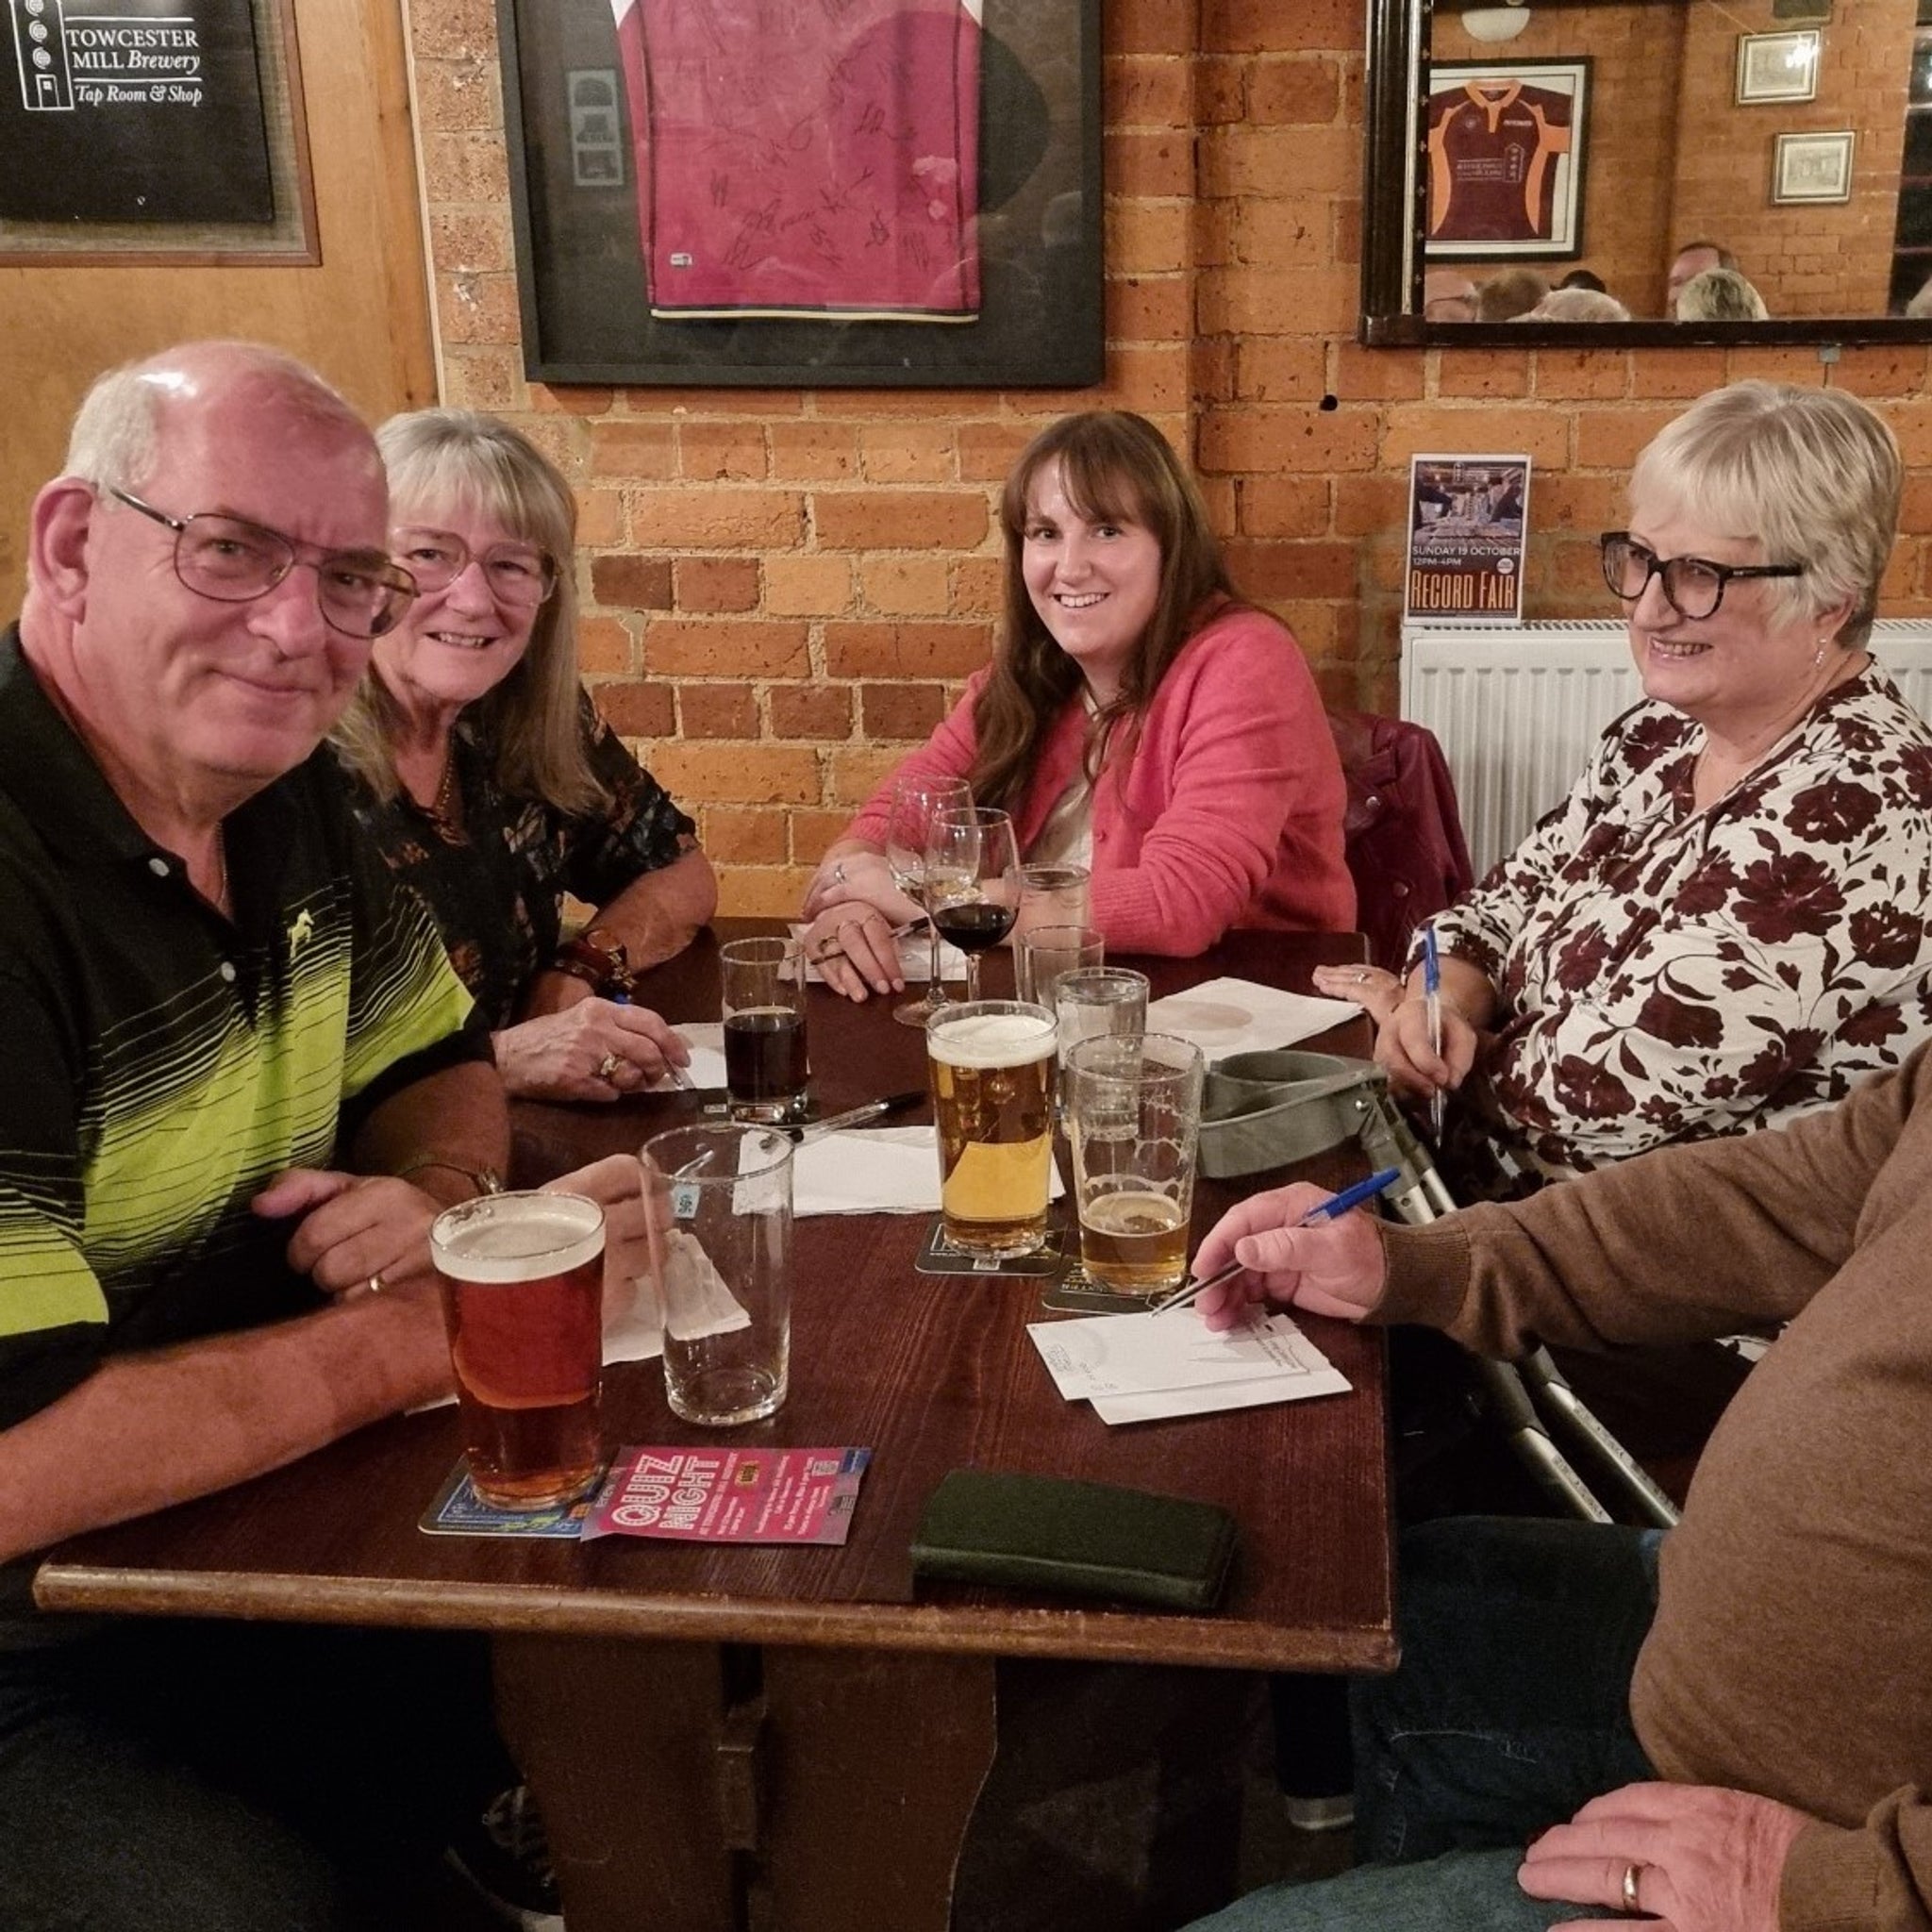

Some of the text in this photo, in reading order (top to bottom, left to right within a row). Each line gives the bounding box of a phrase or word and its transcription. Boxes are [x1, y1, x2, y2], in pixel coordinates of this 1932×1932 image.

[66, 29, 199, 47] TOWCESTER
[72, 49, 200, 75] MILL Brewery
[75, 85, 203, 107] Tap Room & Shop
[1412, 546, 1456, 556] SUNDAY
[1470, 546, 1521, 557] OCTOBER
[611, 1454, 684, 1526] QUIZ
[658, 1456, 720, 1529] NIGHT
